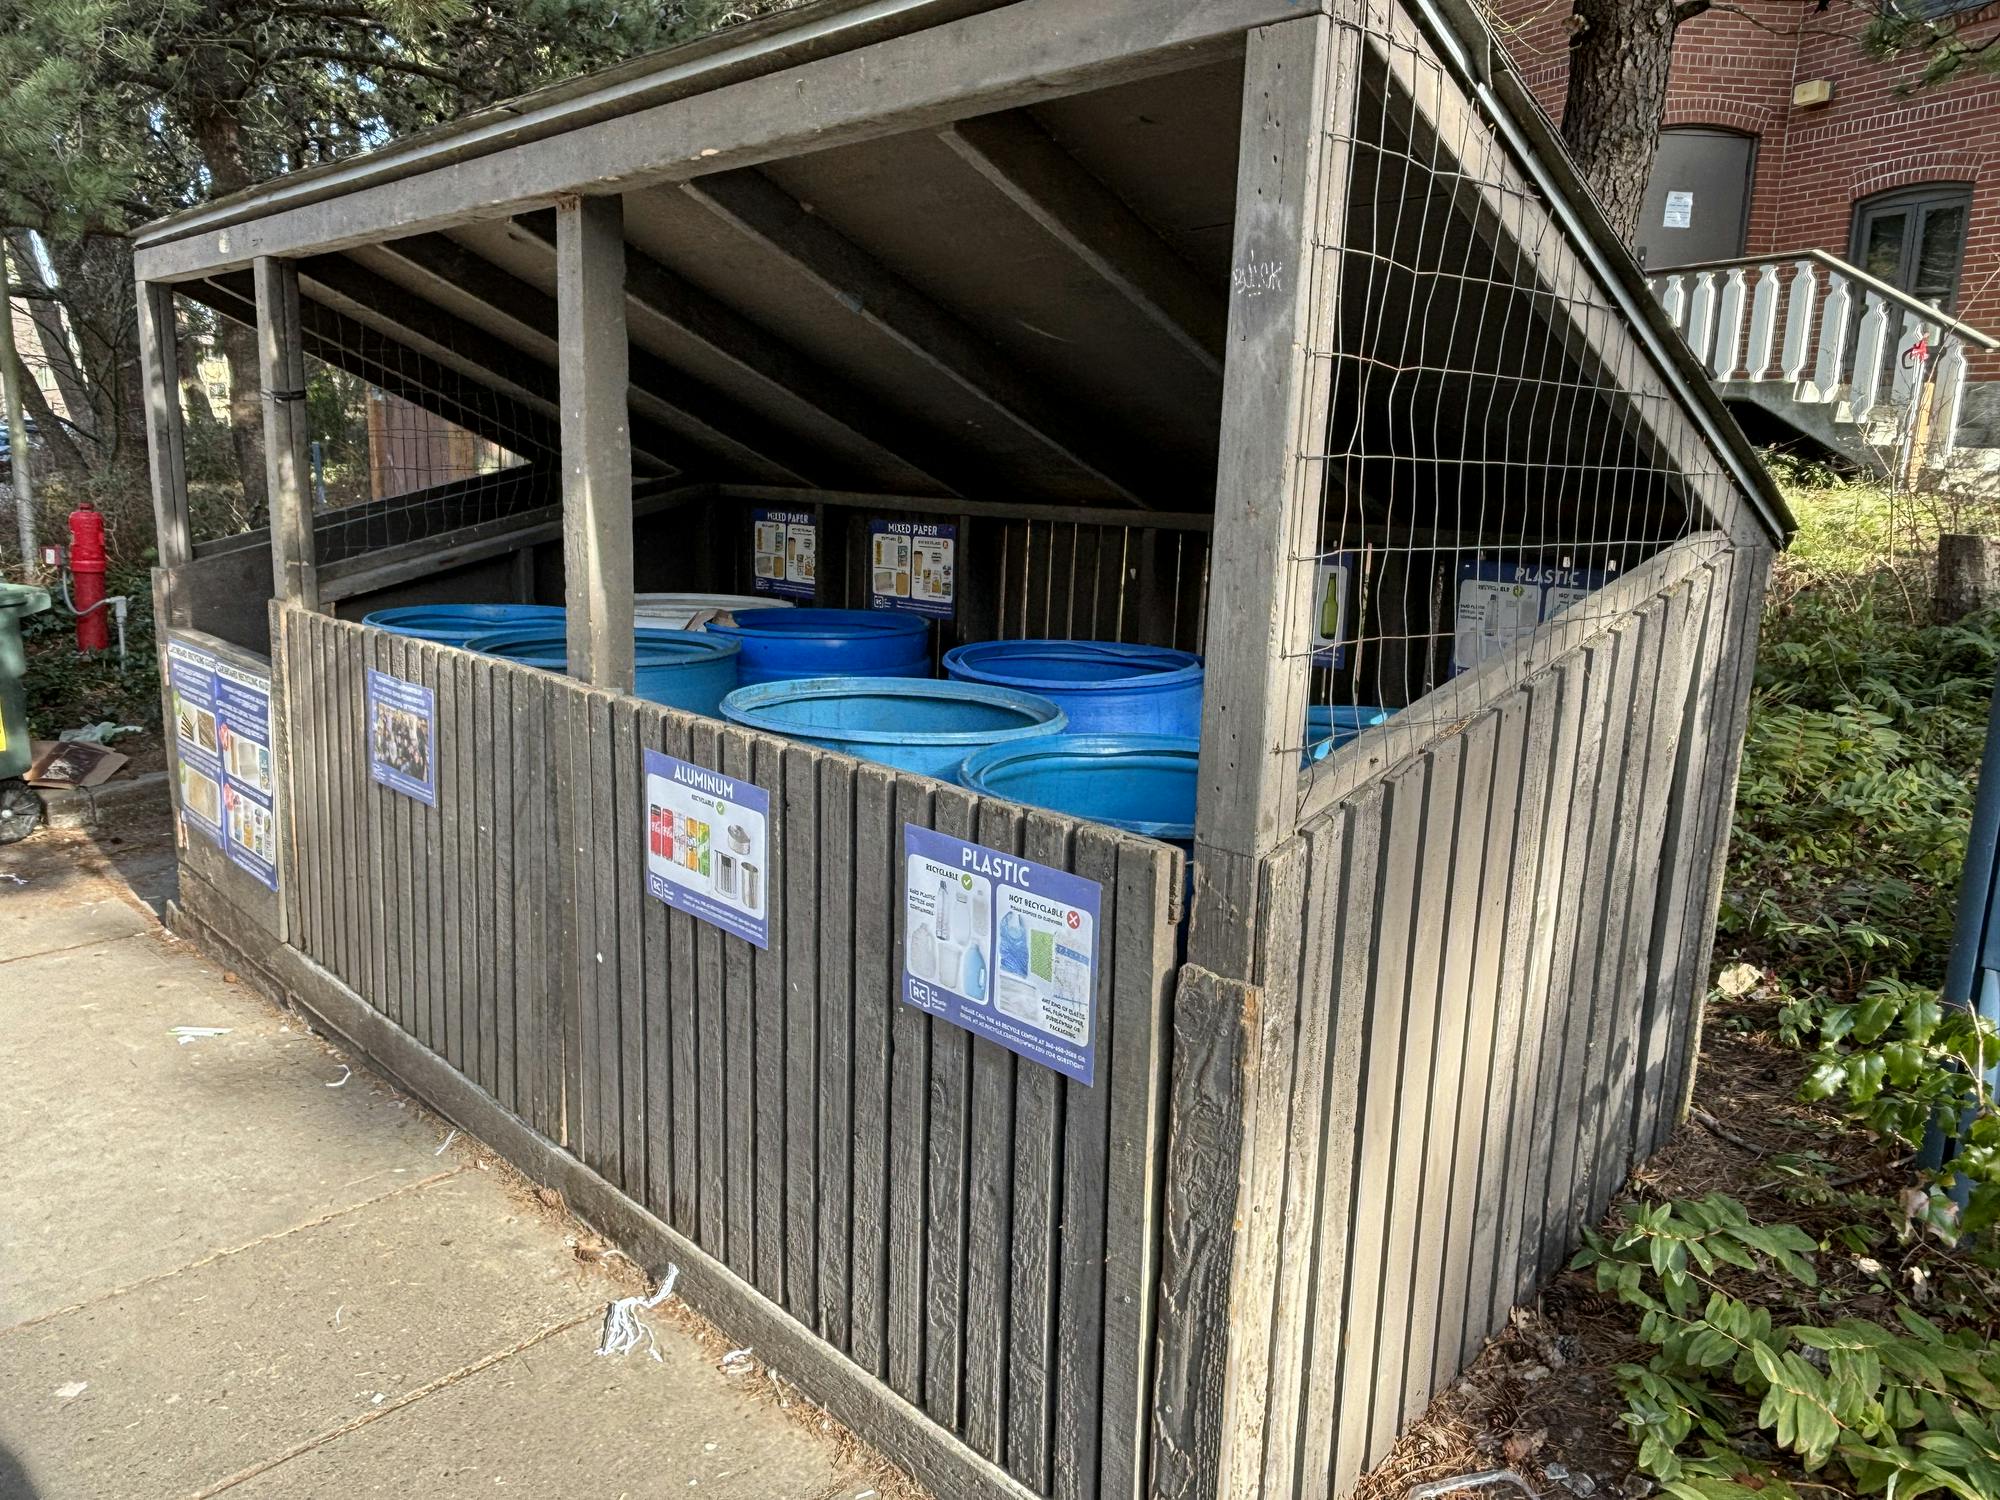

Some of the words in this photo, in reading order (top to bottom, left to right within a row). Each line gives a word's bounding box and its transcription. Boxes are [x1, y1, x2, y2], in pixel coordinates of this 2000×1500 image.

[767, 512, 786, 522] MIXED
[787, 513, 809, 523] PAPER
[888, 523, 911, 534] MIXED
[912, 524, 938, 536] PAPER
[1514, 567, 1580, 586] PLASTIC
[673, 764, 734, 799] ALUMINUM
[926, 863, 958, 881] RECYCLABLE
[962, 846, 1029, 888] PLASTIC
[1008, 892, 1023, 906] NOT
[1024, 897, 1063, 919] RECYCLABLE
[913, 984, 925, 1001] RC
